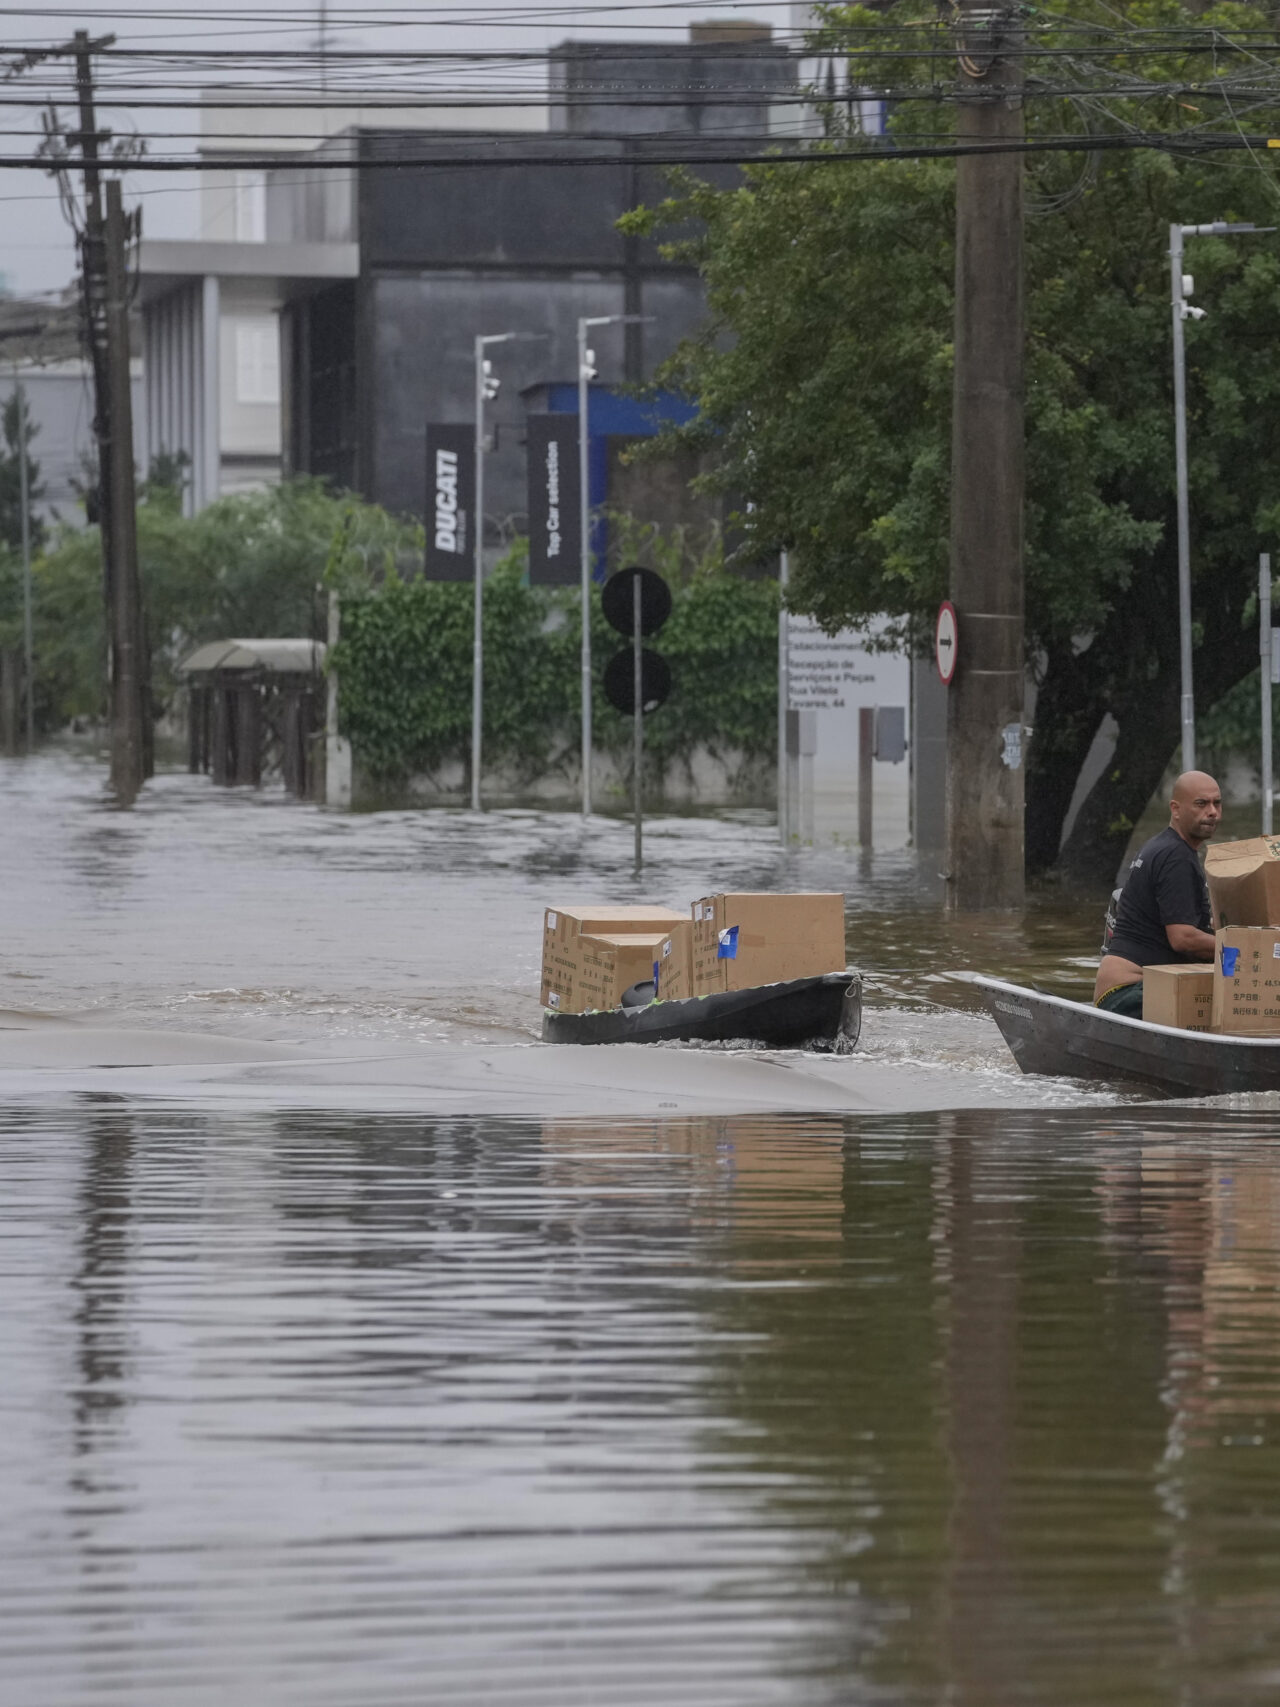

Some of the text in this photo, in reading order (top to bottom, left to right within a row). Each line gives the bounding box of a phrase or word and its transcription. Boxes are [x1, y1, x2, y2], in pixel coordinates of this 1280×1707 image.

[435, 449, 458, 552] DUCATI
[546, 441, 561, 558] Top Car selection
